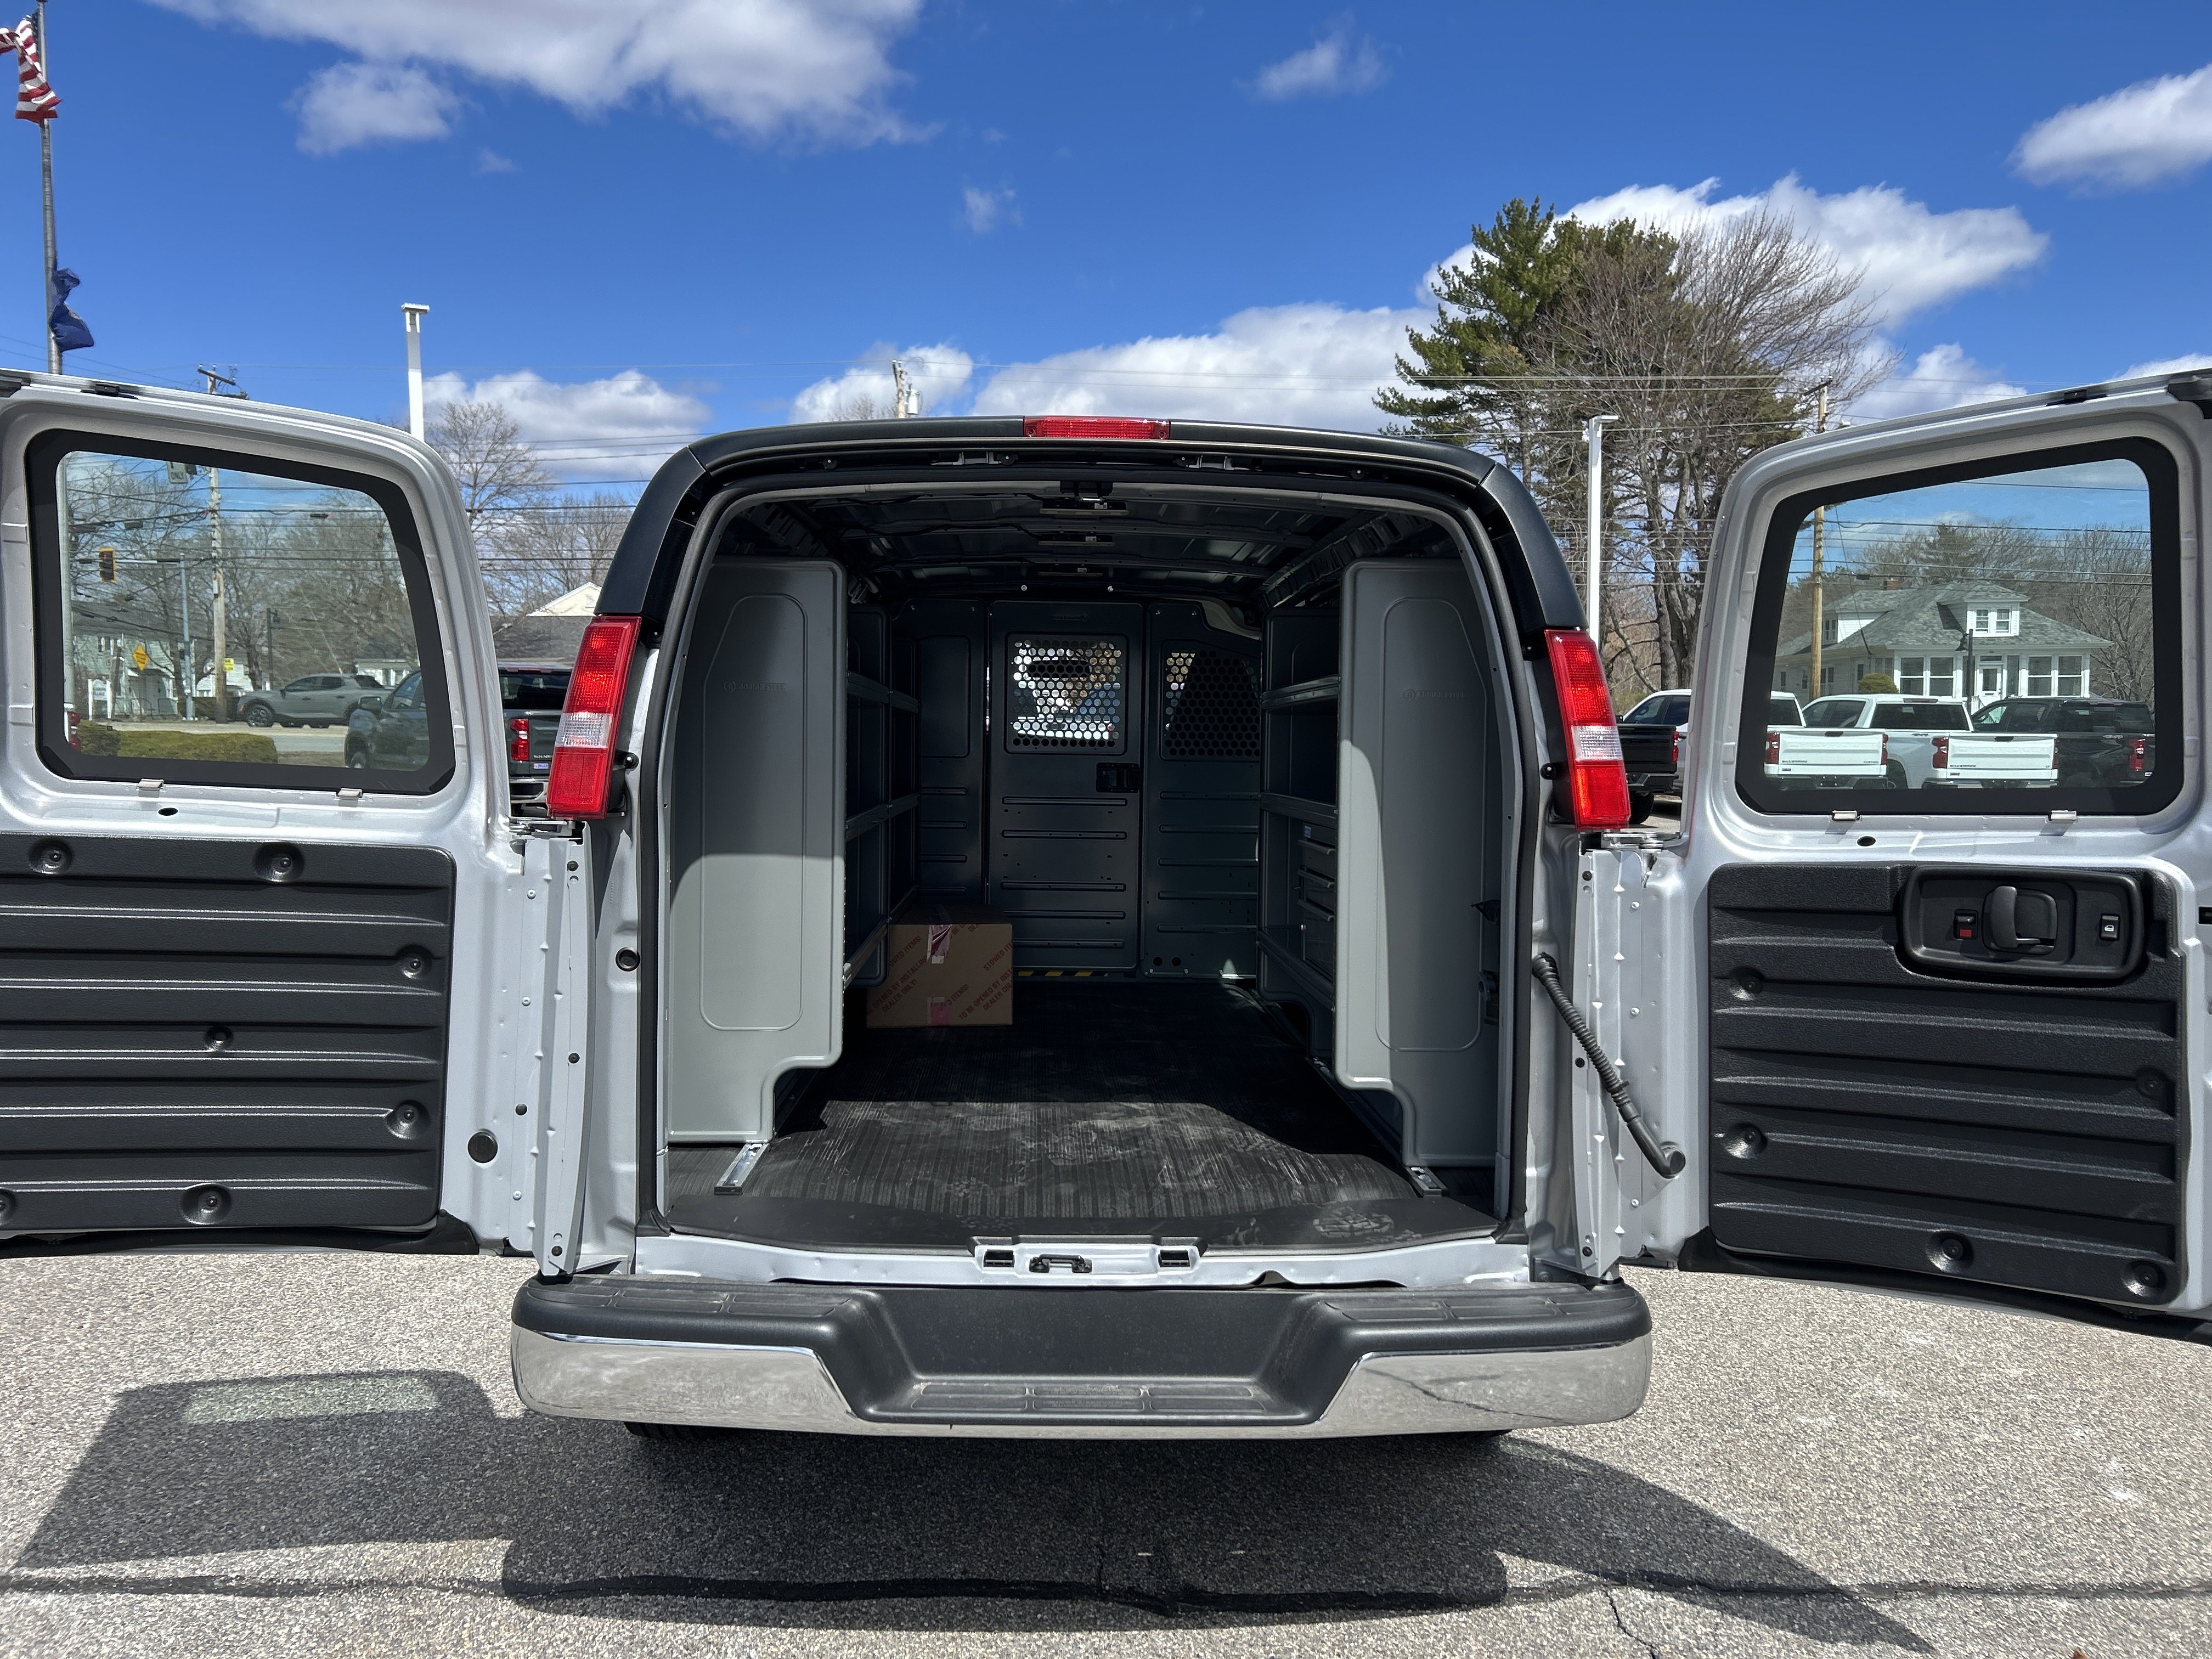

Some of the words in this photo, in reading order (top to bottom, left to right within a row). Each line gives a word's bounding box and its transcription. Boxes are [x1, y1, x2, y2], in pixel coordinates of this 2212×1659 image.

[171, 471, 184, 480] ONLY
[903, 935, 922, 953] ITEMS!
[983, 949, 1005, 971] STOWED
[872, 989, 893, 1009] OPENED
[891, 981, 900, 991] BY
[882, 992, 903, 1013] DEALER
[901, 978, 918, 995] ONLY!
[951, 983, 969, 1001] ITEMS!
[958, 1012, 968, 1020] TO
[966, 1005, 975, 1014] BE
[973, 987, 994, 1007] OPENED
[992, 979, 1001, 989] BY
[983, 991, 1003, 1011] DEALER
